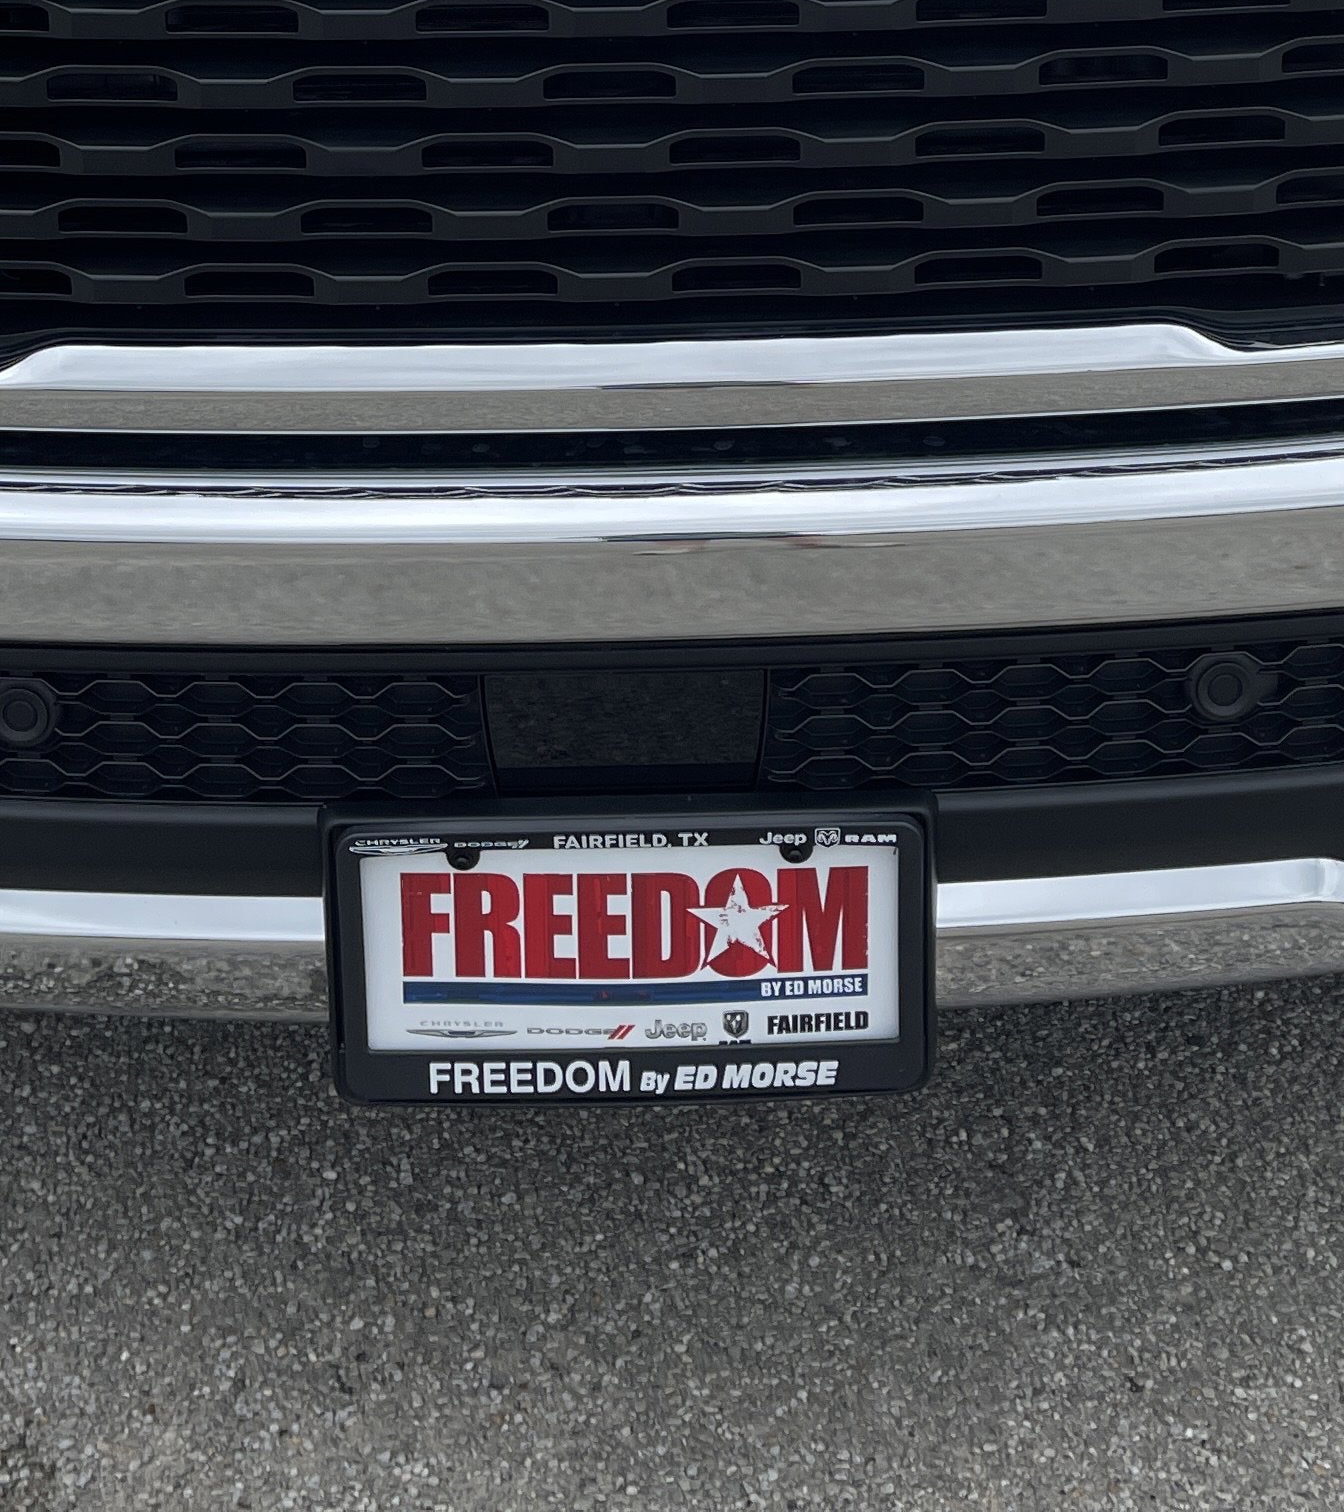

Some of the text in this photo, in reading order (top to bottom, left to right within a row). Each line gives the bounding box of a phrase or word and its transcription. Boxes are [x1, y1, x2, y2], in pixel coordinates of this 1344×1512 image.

[354, 837, 441, 846] CHRYSLER
[553, 832, 709, 849] FAIRFIELD, TX
[759, 831, 807, 846] Jeep
[844, 833, 897, 843] RAM
[399, 865, 868, 979] FREEDOM
[760, 977, 863, 997] BY ED MORSE
[419, 1020, 504, 1028] CHRYSLER
[644, 1019, 707, 1042] Jeep
[767, 1011, 869, 1035] FAIRFIELD
[429, 1059, 839, 1095] FREEDOM By ED MORSE
